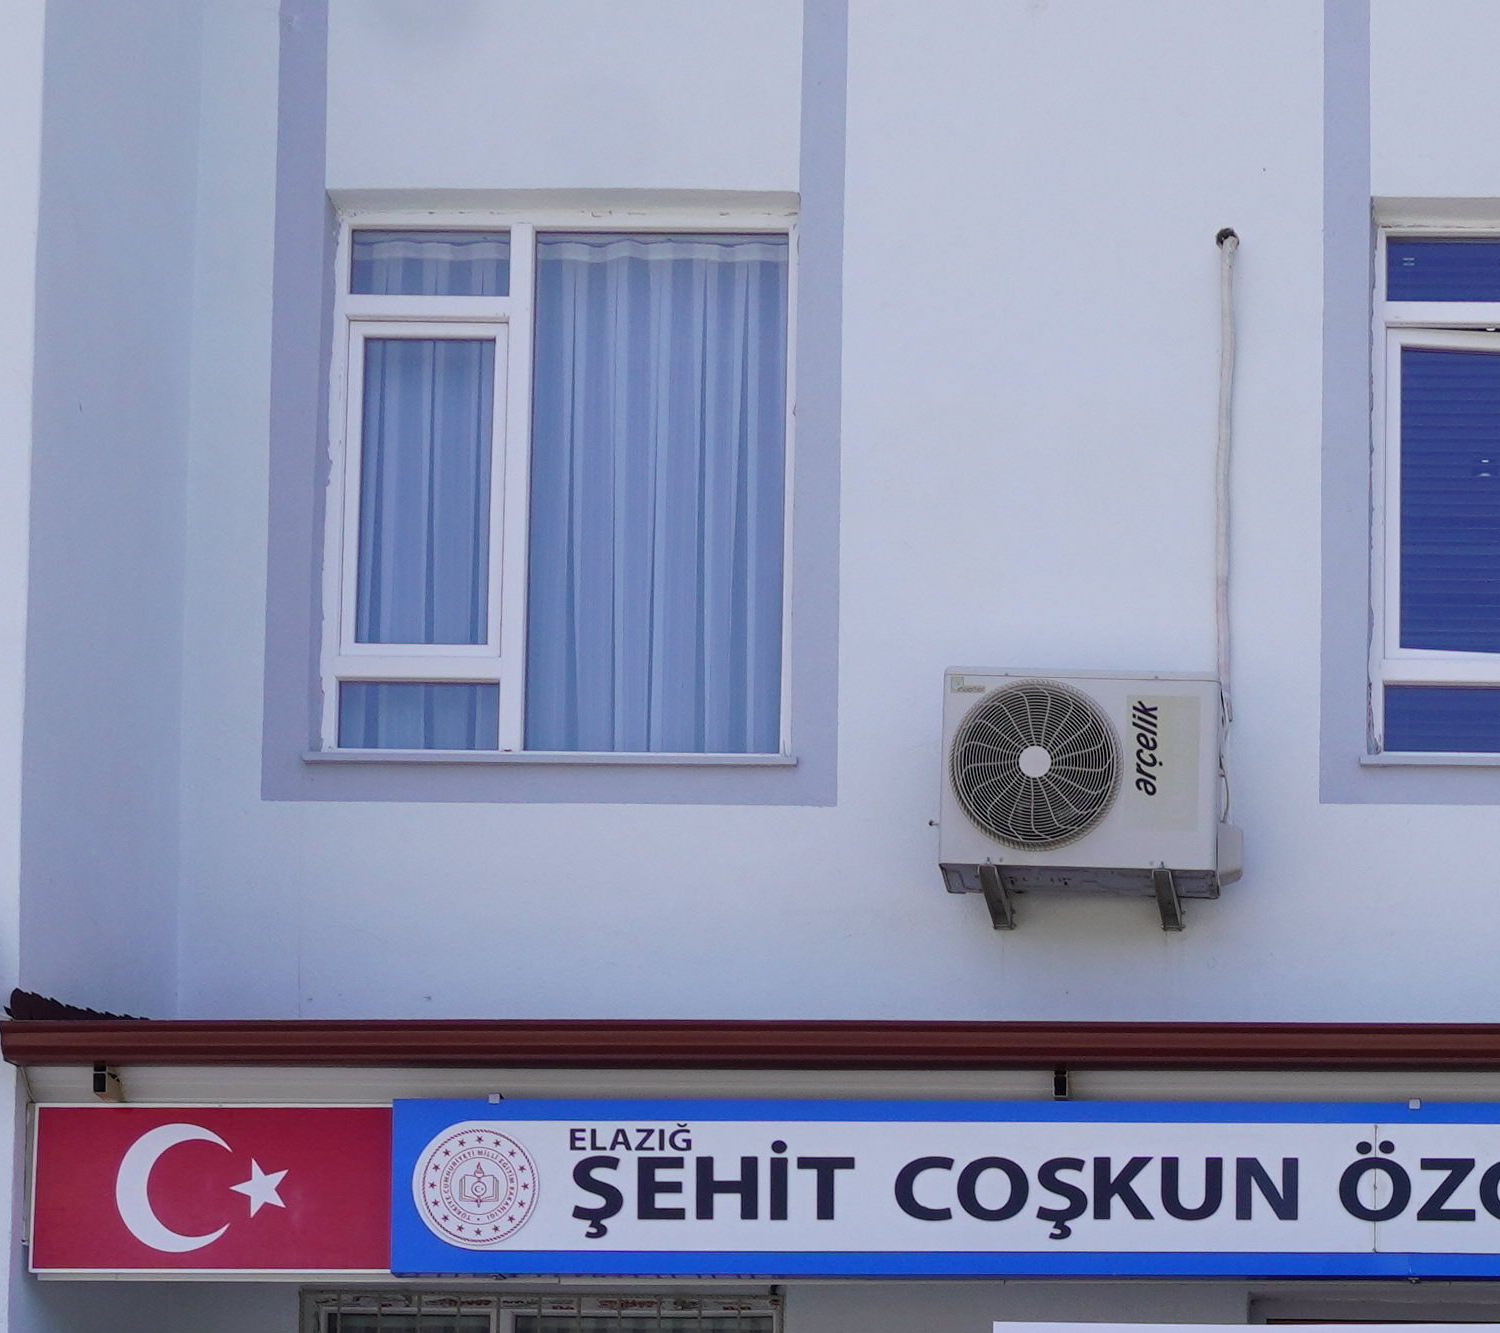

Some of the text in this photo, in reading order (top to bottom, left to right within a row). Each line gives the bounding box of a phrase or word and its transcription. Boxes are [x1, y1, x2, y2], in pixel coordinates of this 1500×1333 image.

[1132, 700, 1164, 797] arçelik
[569, 1124, 693, 1152] ELAZIĞ
[570, 1140, 855, 1239] ŞEHİT
[894, 1154, 1300, 1239] COŞKUN
